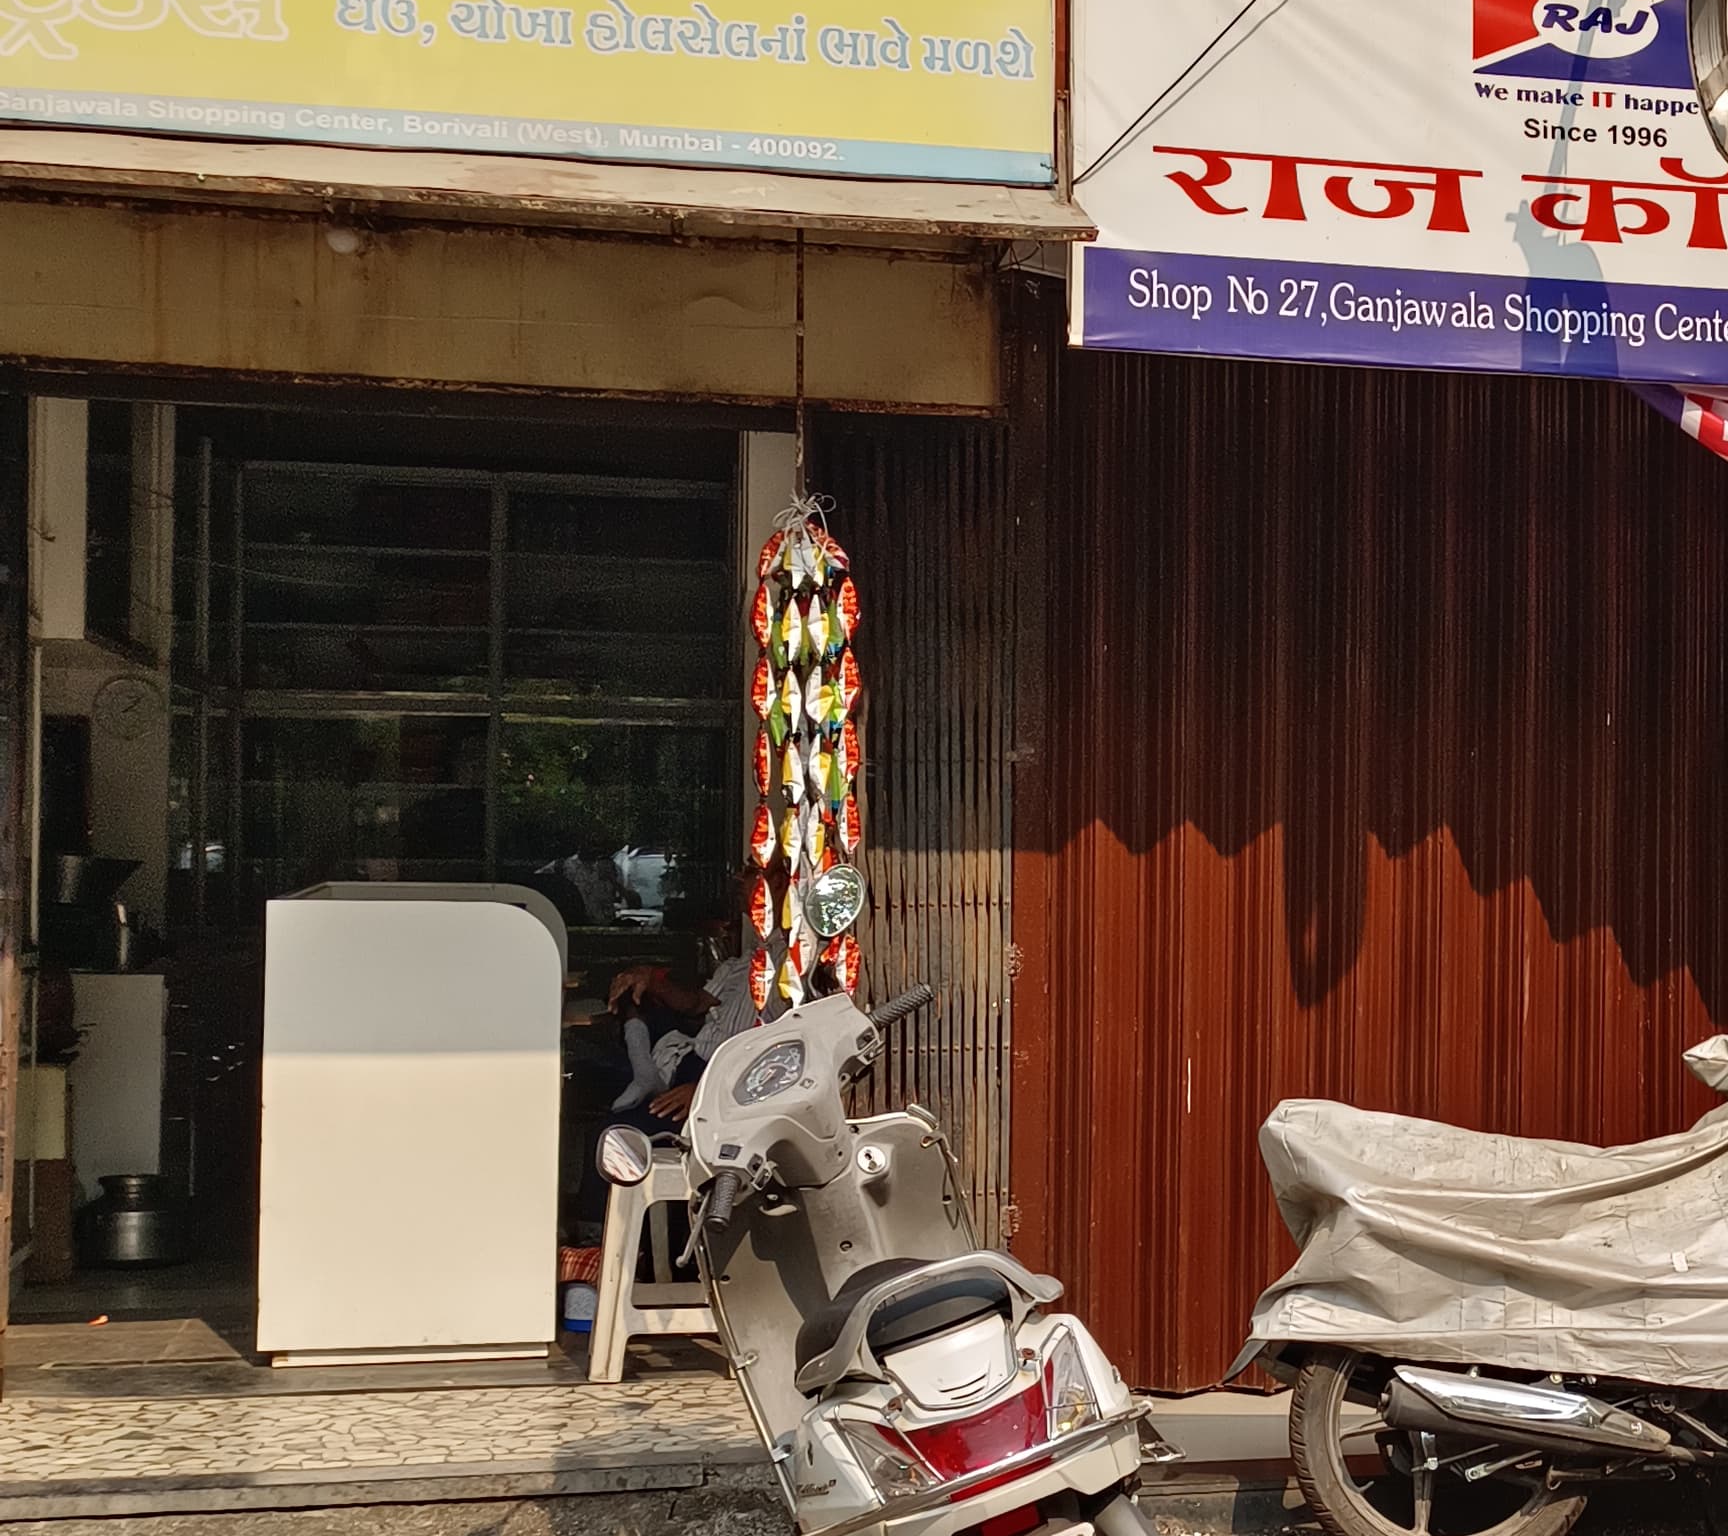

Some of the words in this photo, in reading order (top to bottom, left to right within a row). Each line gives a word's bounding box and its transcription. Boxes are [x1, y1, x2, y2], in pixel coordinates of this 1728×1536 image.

[1542, 3, 1650, 35] RAJ
[1474, 82, 1508, 101] We
[1516, 88, 1585, 106] make
[1592, 91, 1616, 108] IT
[147, 99, 286, 131] Shopping
[295, 108, 394, 135] Center,
[402, 114, 508, 140] Borivali
[516, 119, 609, 149] (West),
[618, 127, 722, 153] Mumbai
[746, 136, 846, 162] 400092.
[1523, 118, 1598, 142] Since
[1607, 125, 1668, 148] 1996
[1153, 144, 1484, 234] राज
[1127, 267, 1213, 320] Shop
[1226, 274, 1270, 317] No
[1503, 293, 1646, 346] Shopping
